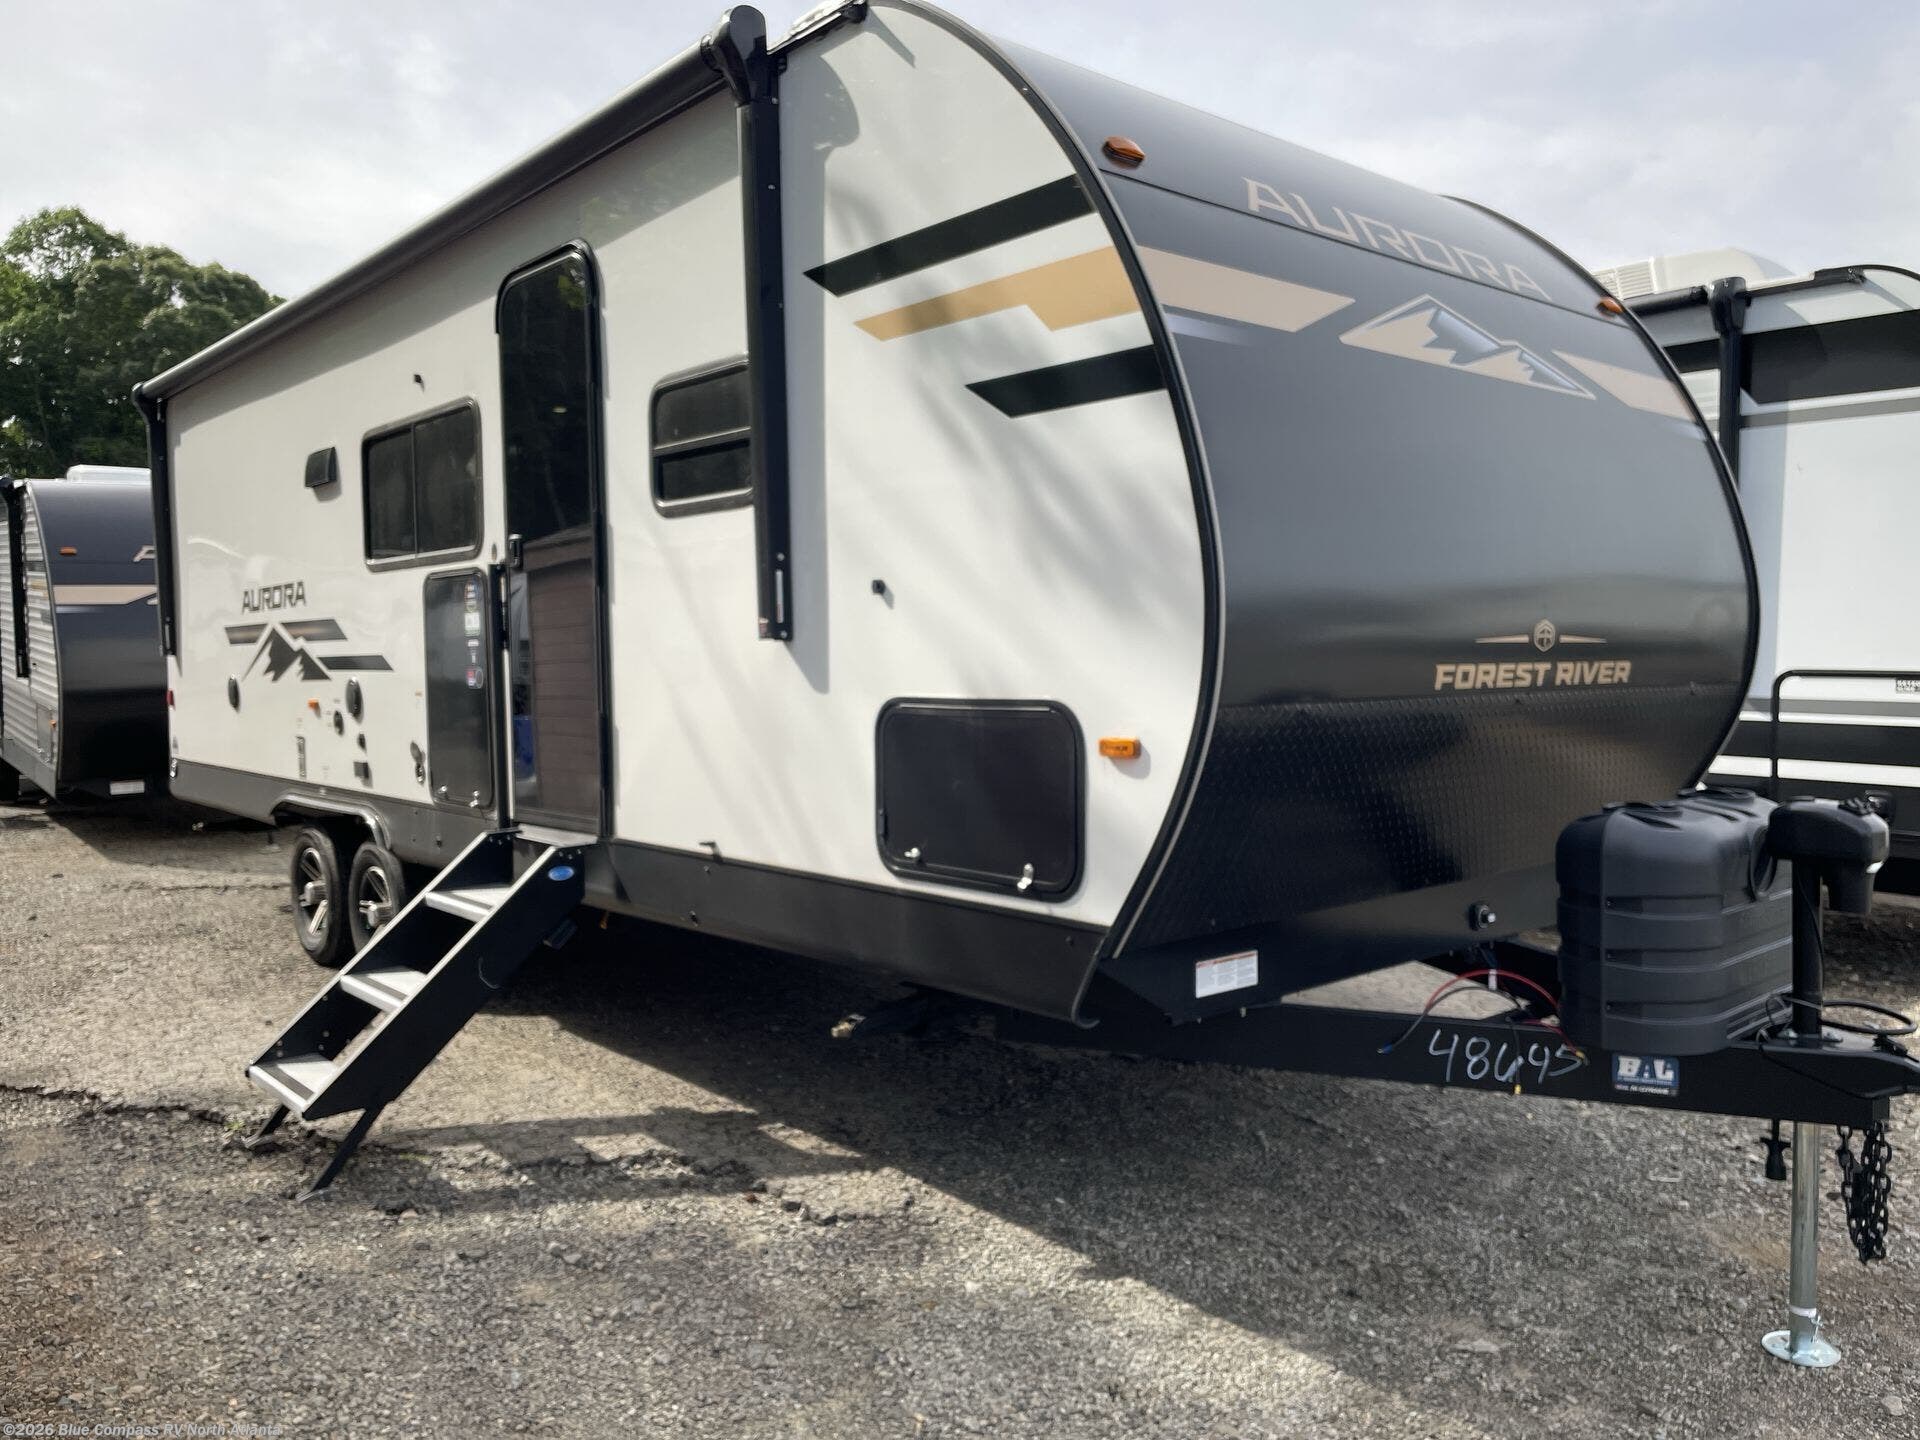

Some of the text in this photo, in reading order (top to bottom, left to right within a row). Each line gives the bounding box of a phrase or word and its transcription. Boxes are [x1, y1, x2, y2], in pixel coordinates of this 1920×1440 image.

[1241, 176, 1553, 301] AURORA
[241, 580, 306, 614] AURORA
[1433, 659, 1633, 692] FOREST RIVER
